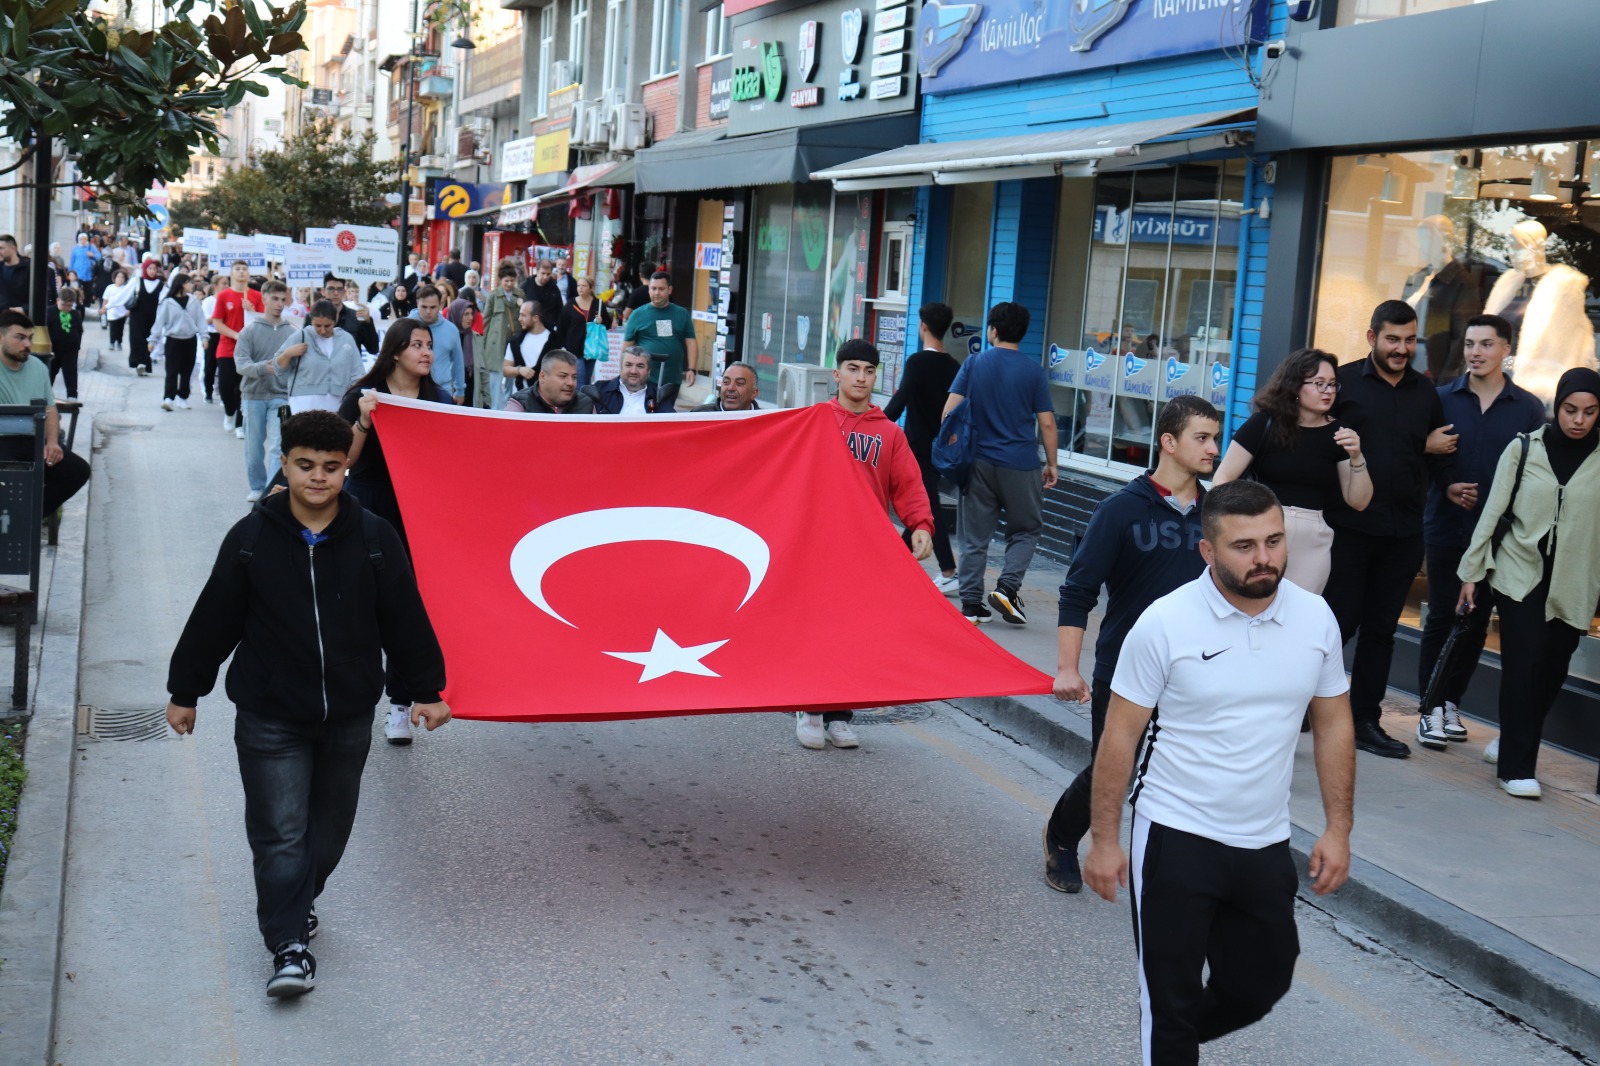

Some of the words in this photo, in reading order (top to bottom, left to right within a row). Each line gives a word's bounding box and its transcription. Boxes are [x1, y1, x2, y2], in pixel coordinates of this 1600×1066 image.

[790, 87, 818, 107] GANYAN
[357, 256, 373, 265] ÜNYE
[337, 265, 353, 273] YURT
[354, 266, 391, 277] MÜDÜRLÜĞÜ
[842, 430, 883, 468] AVİ
